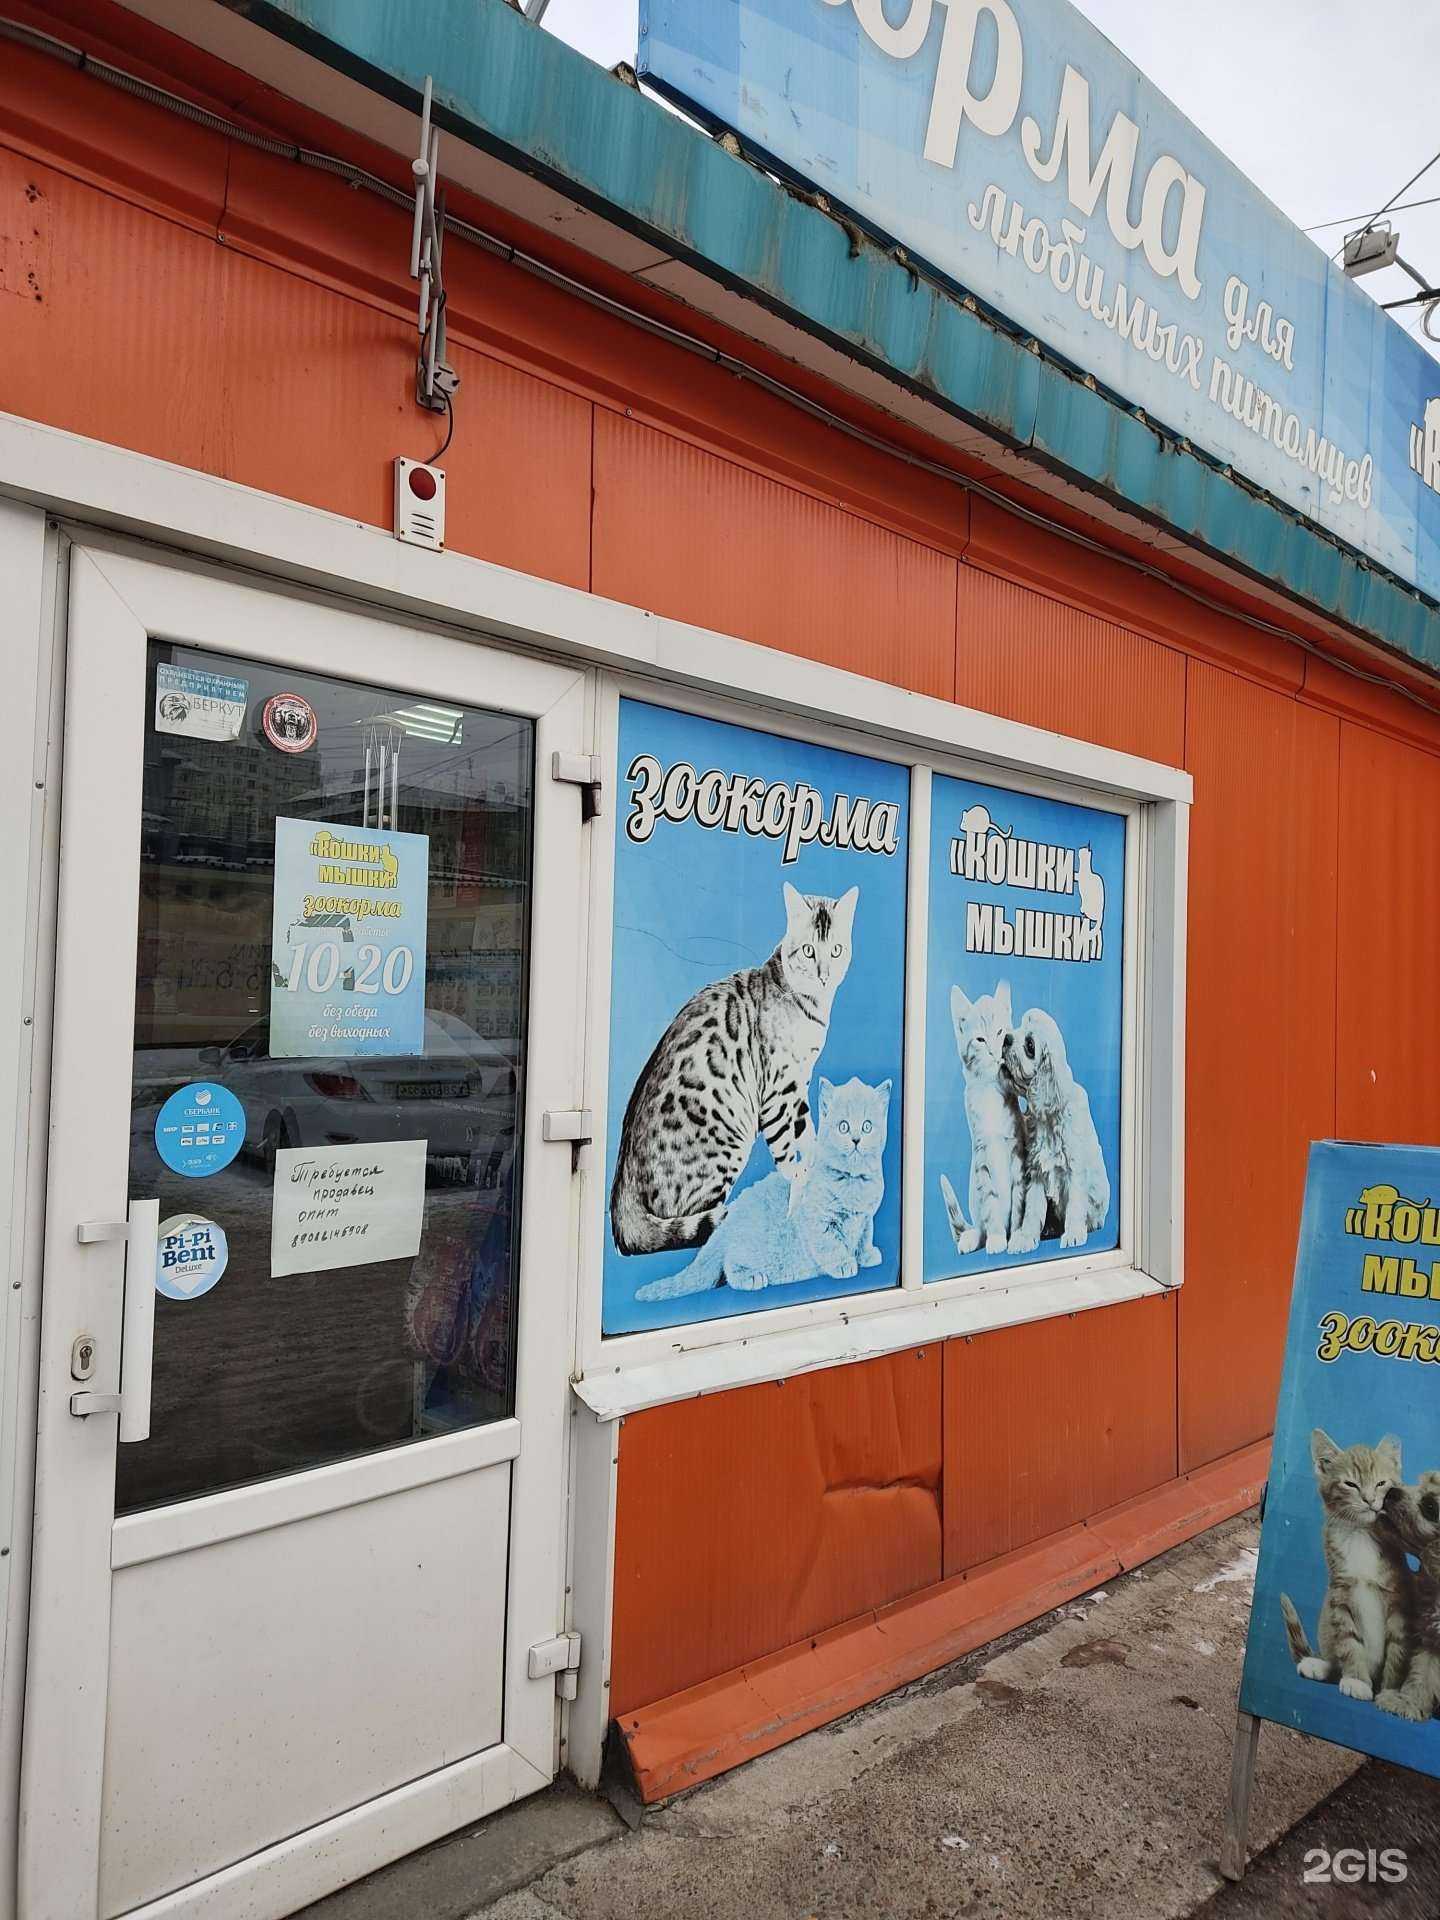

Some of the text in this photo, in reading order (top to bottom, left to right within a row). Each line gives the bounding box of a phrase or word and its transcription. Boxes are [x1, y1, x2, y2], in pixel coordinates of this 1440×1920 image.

[1223, 273, 1297, 372] для
[967, 183, 1373, 510] любимых питомцев
[193, 697, 245, 717] БЕРКУТ
[624, 753, 902, 866] зоокорма
[302, 894, 402, 921] зоокорма
[322, 1003, 379, 1019] без обеда
[308, 1023, 391, 1042] без выходных
[184, 1107, 222, 1116] СБЕРБАНК
[290, 1160, 385, 1188] Требуется
[312, 1183, 375, 1203] продавец
[163, 1228, 212, 1250] Pi-Pi
[162, 1244, 216, 1269] Bent
[1316, 1310, 1440, 1366] зоок
